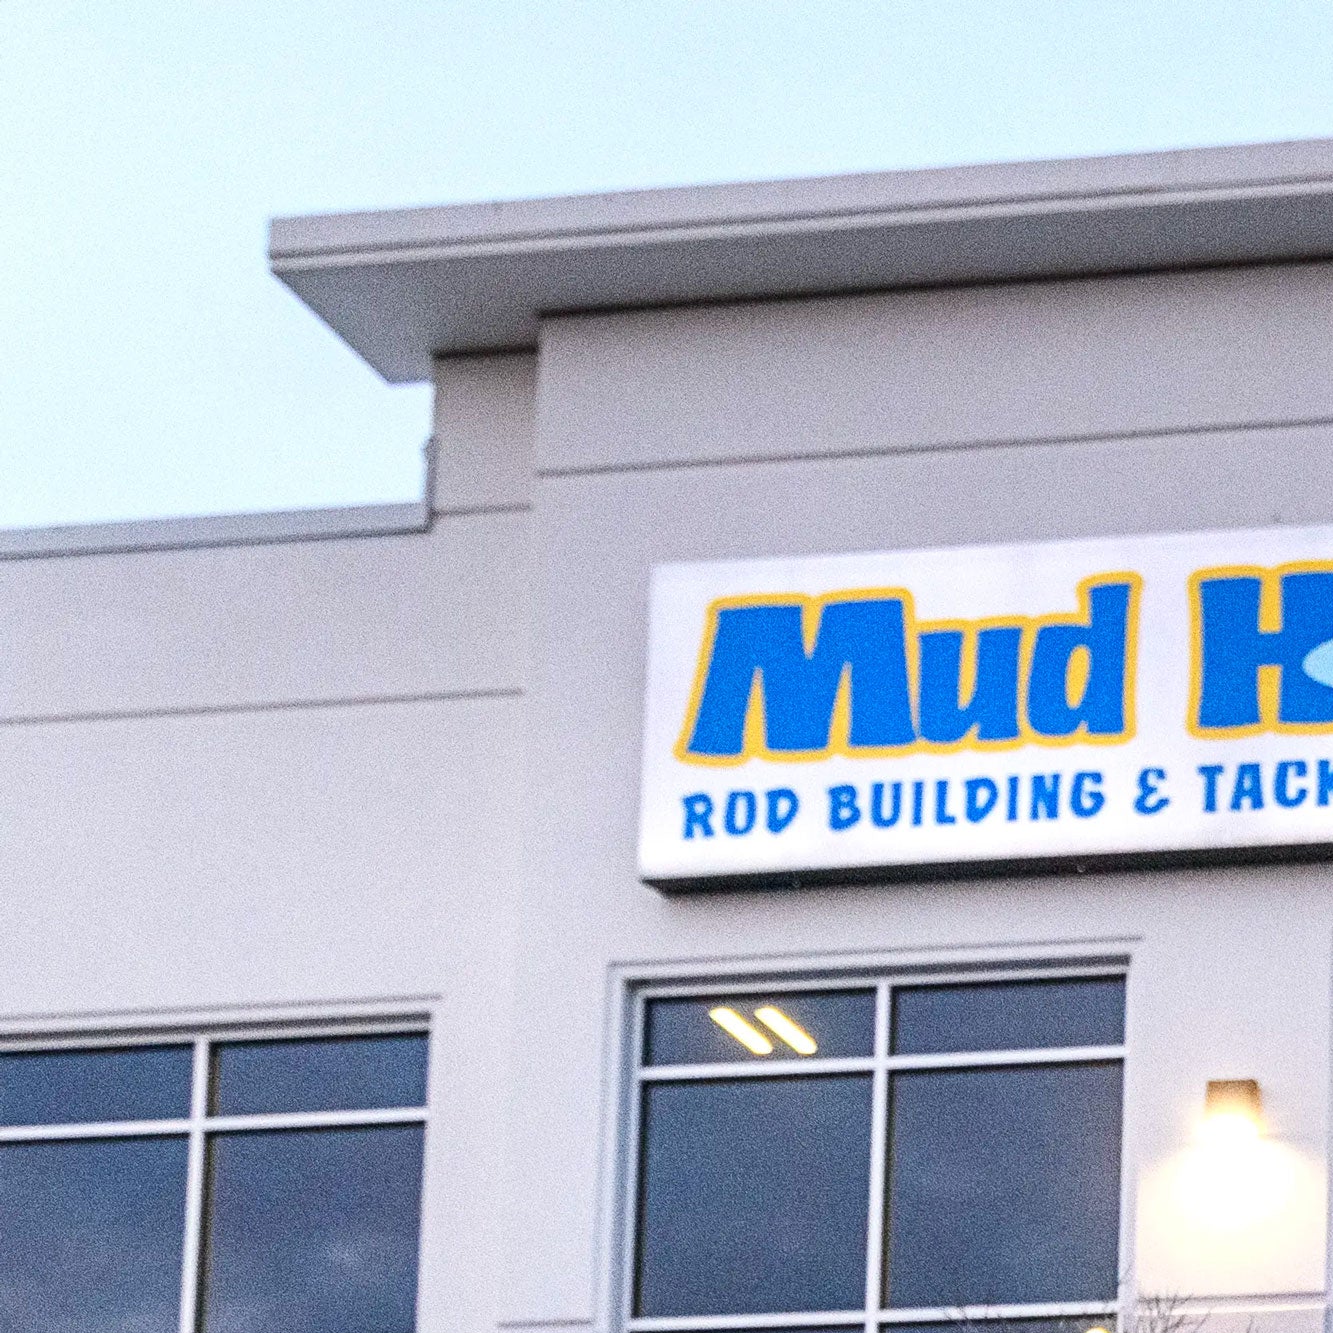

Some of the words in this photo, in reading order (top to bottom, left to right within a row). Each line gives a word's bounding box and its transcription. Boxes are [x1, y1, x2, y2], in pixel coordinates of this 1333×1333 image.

[675, 570, 1142, 765] Mud
[682, 788, 797, 839] ROD
[826, 772, 1105, 832] BUILDING
[1134, 770, 1169, 812] &
